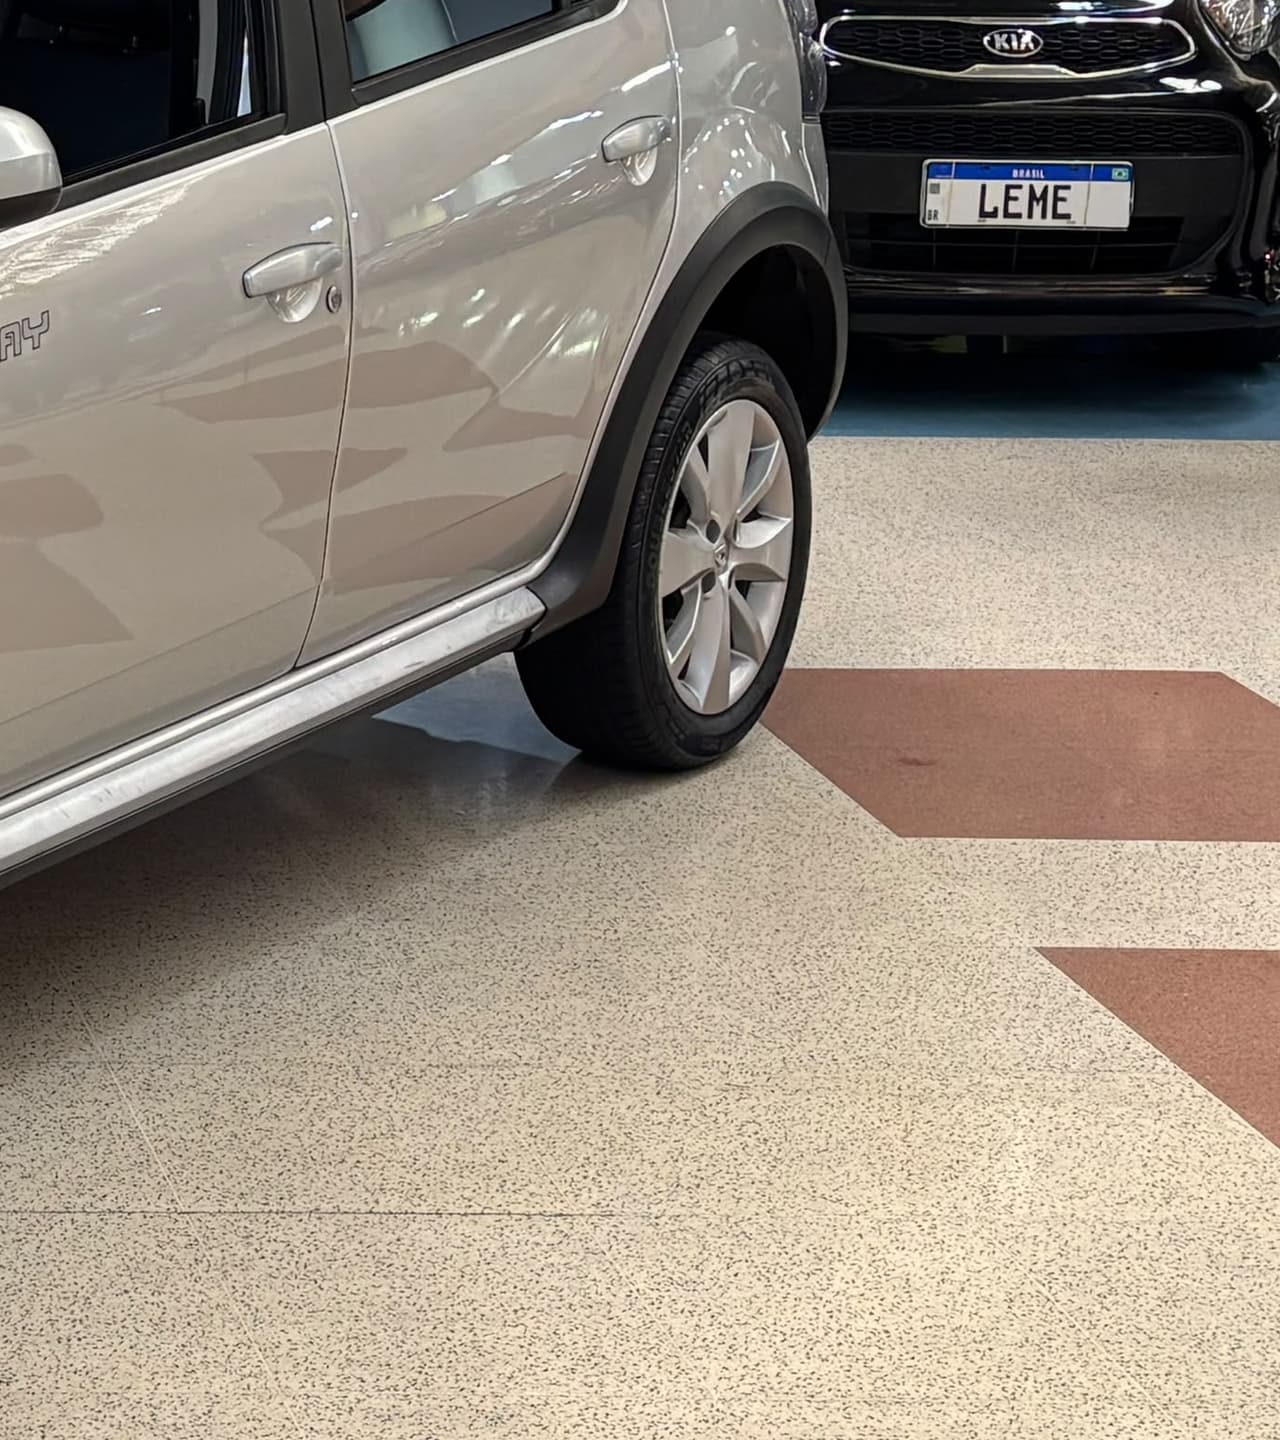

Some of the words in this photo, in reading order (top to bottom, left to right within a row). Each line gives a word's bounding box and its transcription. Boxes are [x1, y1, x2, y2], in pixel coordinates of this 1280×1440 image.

[994, 32, 1036, 50] KIA
[1012, 168, 1045, 179] BRASIL
[978, 183, 1073, 220] LEME
